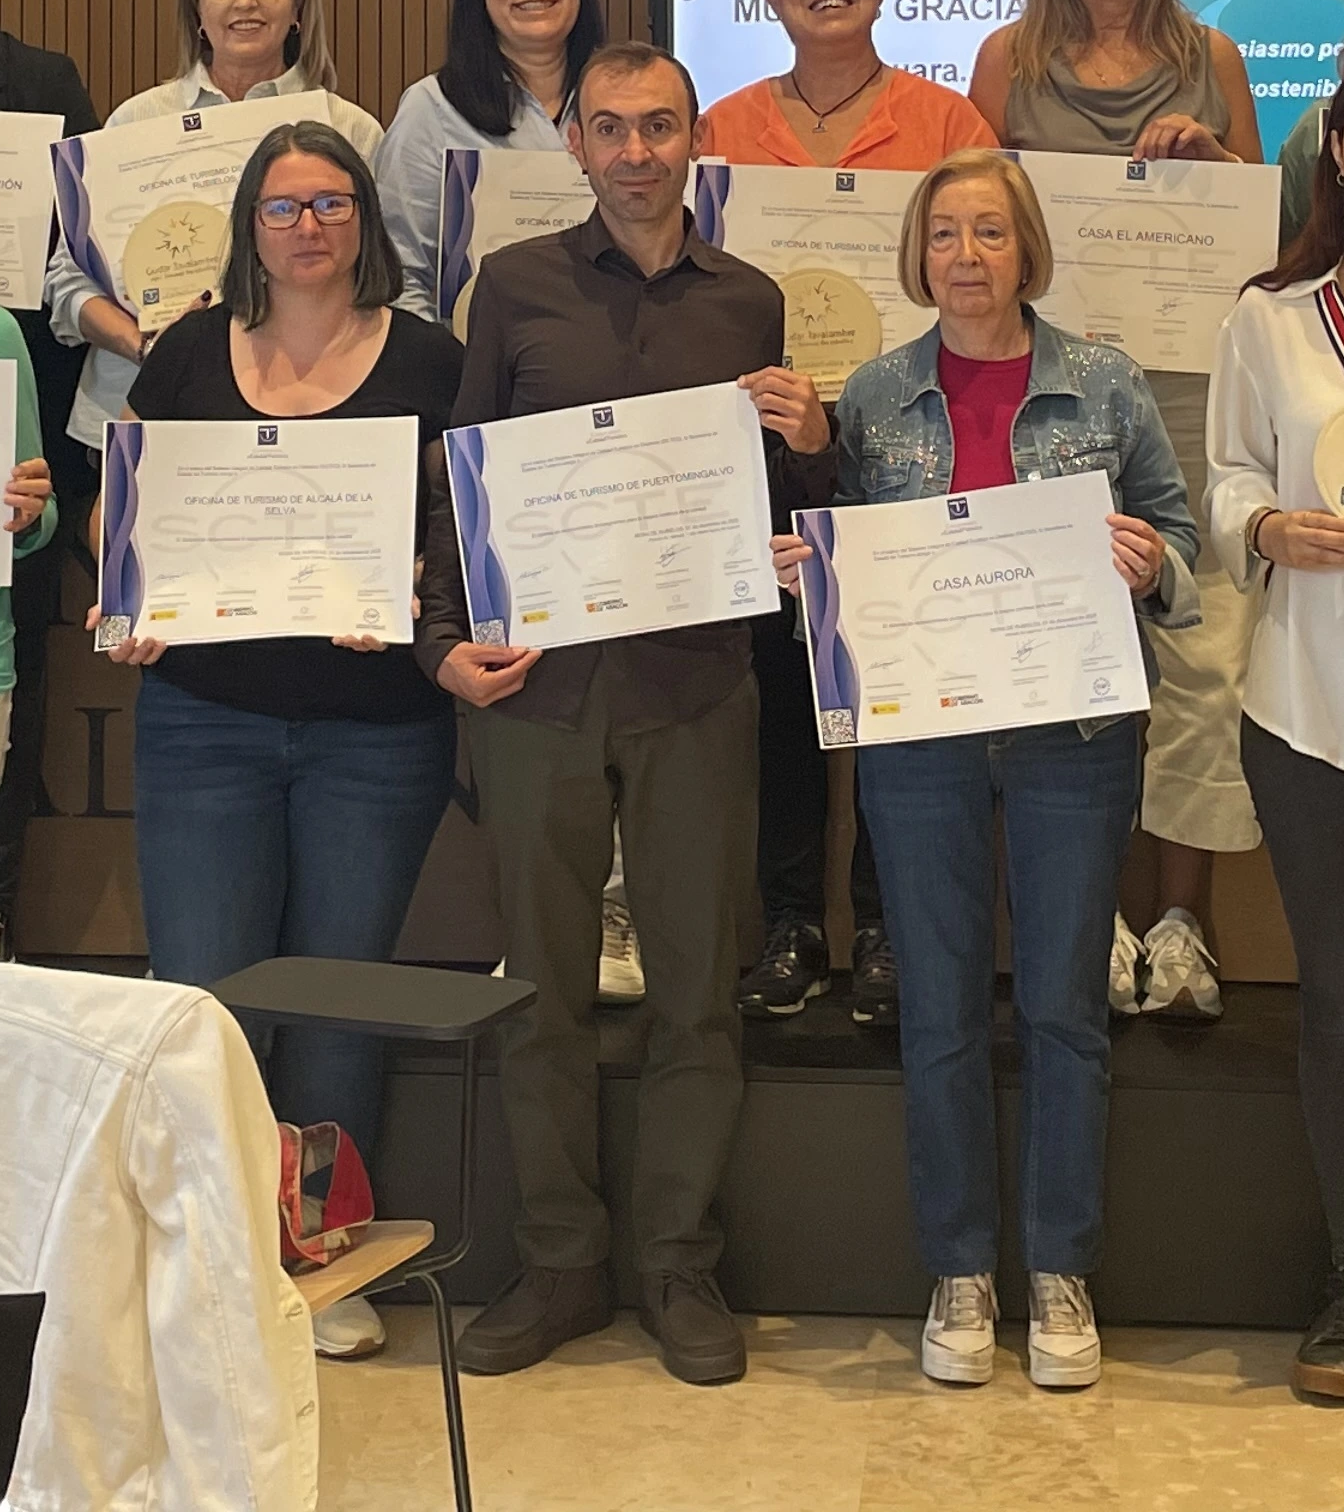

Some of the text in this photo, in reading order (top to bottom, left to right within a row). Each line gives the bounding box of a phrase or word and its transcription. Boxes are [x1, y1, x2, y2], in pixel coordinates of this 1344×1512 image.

[1237, 40, 1315, 58] siasmo
[1078, 227, 1214, 247] CASA EL AMERICANO
[227, 495, 241, 504] DE
[290, 494, 304, 504] DE
[345, 492, 359, 502] DE
[361, 492, 373, 501] LA
[524, 493, 562, 508] OFICINA
[565, 489, 578, 500] DE
[626, 480, 641, 490] DE
[933, 566, 1035, 592] CASA AURORA
